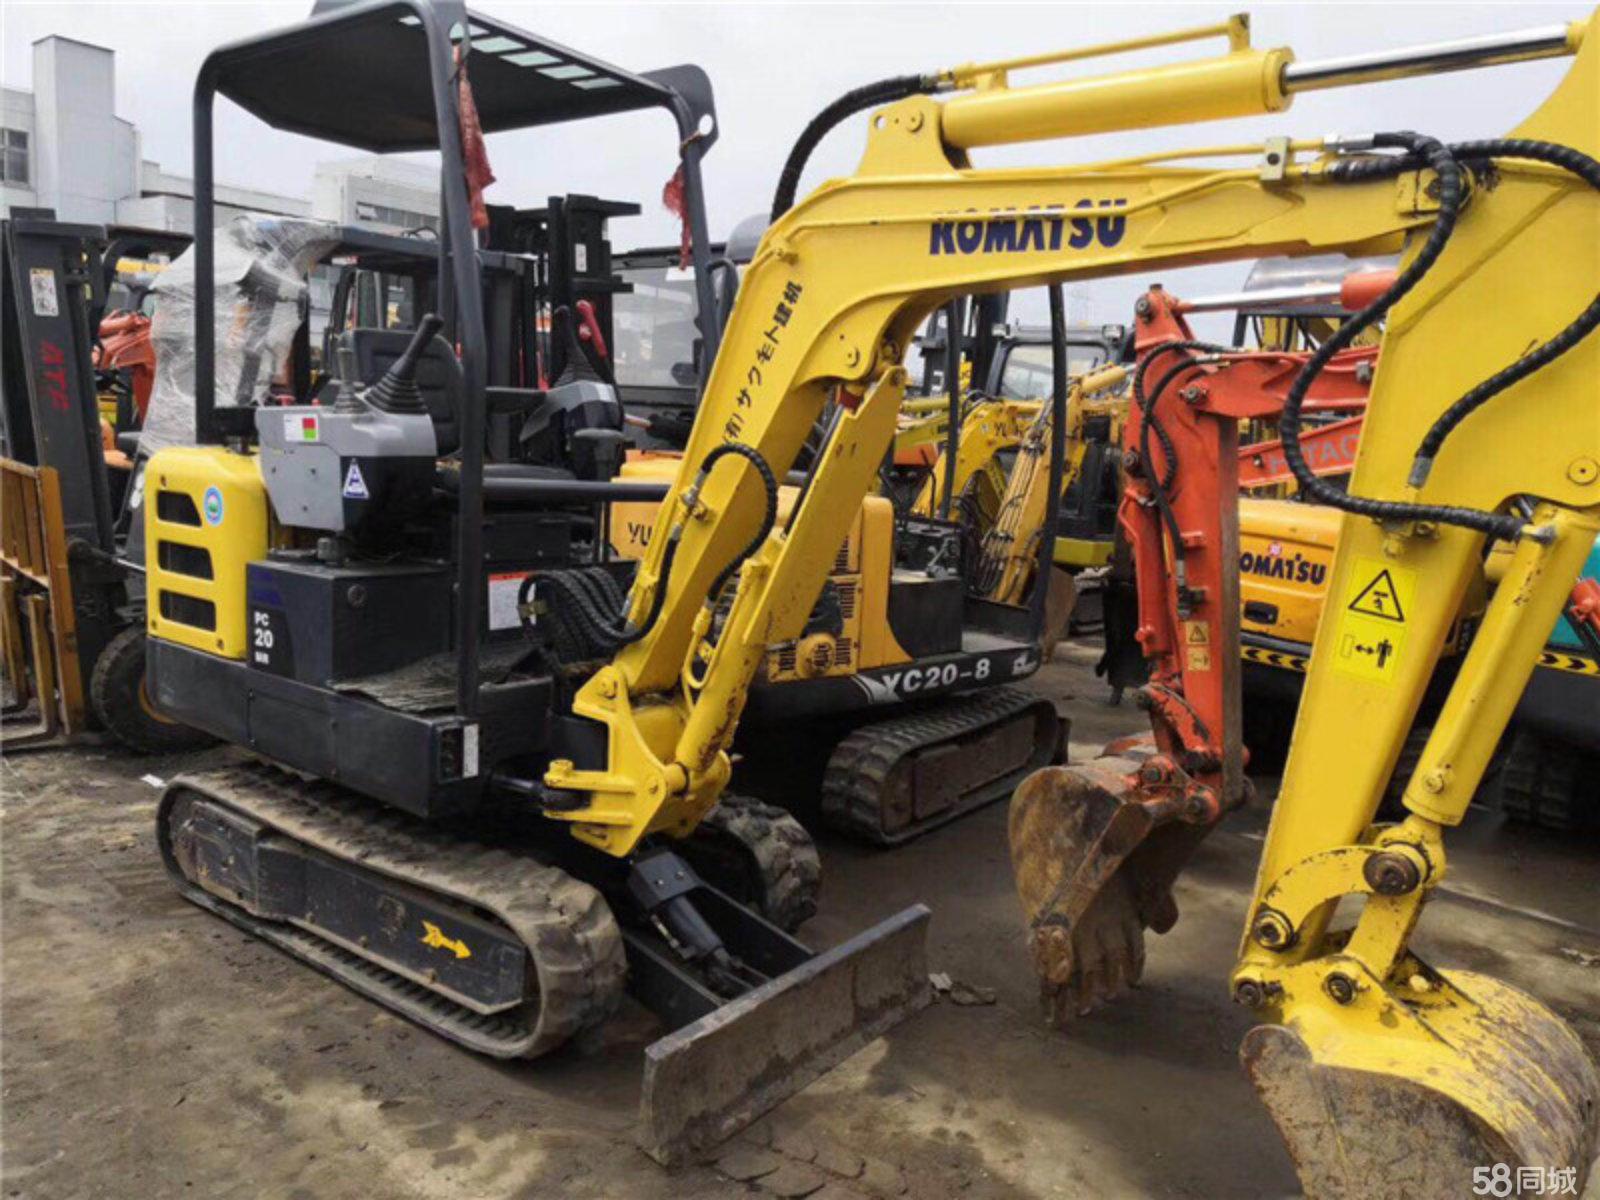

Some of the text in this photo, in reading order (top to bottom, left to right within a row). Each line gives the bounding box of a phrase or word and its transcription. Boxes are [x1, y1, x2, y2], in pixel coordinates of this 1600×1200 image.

[929, 199, 1127, 256] KOMATSU
[1268, 433, 1361, 475] HTAC
[254, 611, 270, 627] PC
[254, 628, 273, 649] 20
[881, 657, 991, 697] YC20-8
